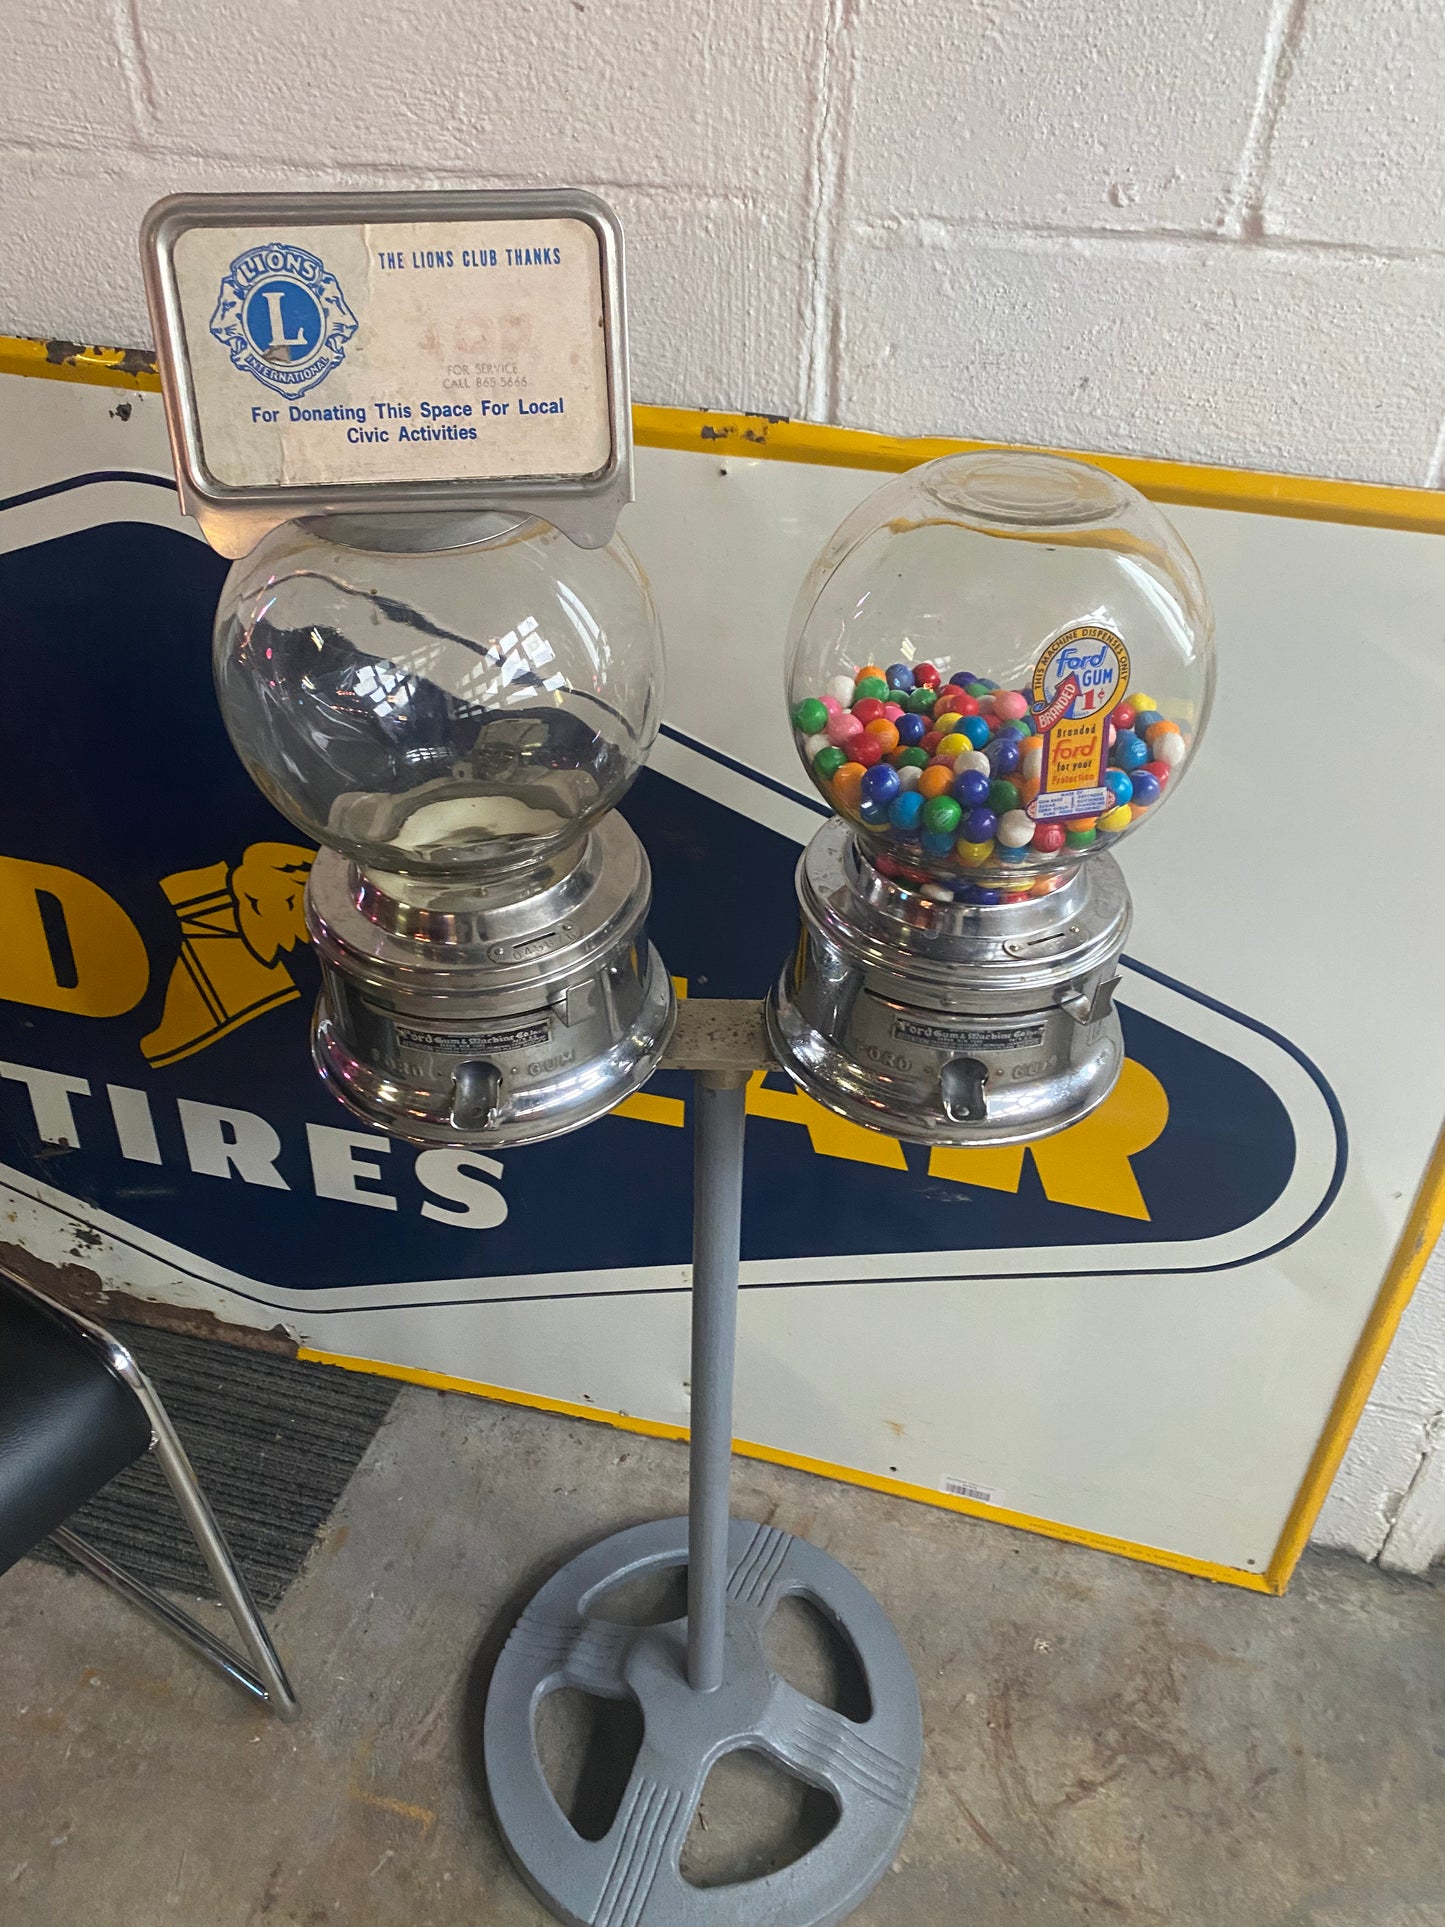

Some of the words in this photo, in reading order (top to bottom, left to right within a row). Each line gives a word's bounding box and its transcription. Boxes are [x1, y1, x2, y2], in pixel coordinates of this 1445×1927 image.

[238, 250, 318, 282] LIONS
[378, 252, 405, 270] THE
[412, 251, 454, 269] LIONS
[462, 250, 497, 267] CLUB
[505, 248, 561, 266] THANKS
[262, 292, 308, 346] L
[246, 355, 330, 384] INTERNATIONAL
[447, 364, 471, 377] FOR
[442, 377, 471, 390] CALL
[251, 406, 280, 423] For
[288, 404, 367, 424] Donating
[374, 402, 412, 419] This
[420, 401, 473, 422] Space
[481, 400, 510, 416] For
[518, 397, 564, 415] Local
[346, 426, 390, 443] Civic
[398, 424, 478, 442] Activities
[1034, 668, 1044, 690] THIS
[1042, 630, 1079, 666] MACHINE
[1081, 628, 1123, 656] DISPENSES
[1119, 655, 1129, 681] ONLY
[1082, 668, 1113, 687] GUM
[1037, 683, 1076, 729] BRANDED
[1056, 723, 1097, 738] Branded
[1056, 761, 1070, 772] for
[1072, 759, 1093, 772] your
[526, 1049, 576, 1077] GUM
[0, 1060, 509, 1230] TIRES
